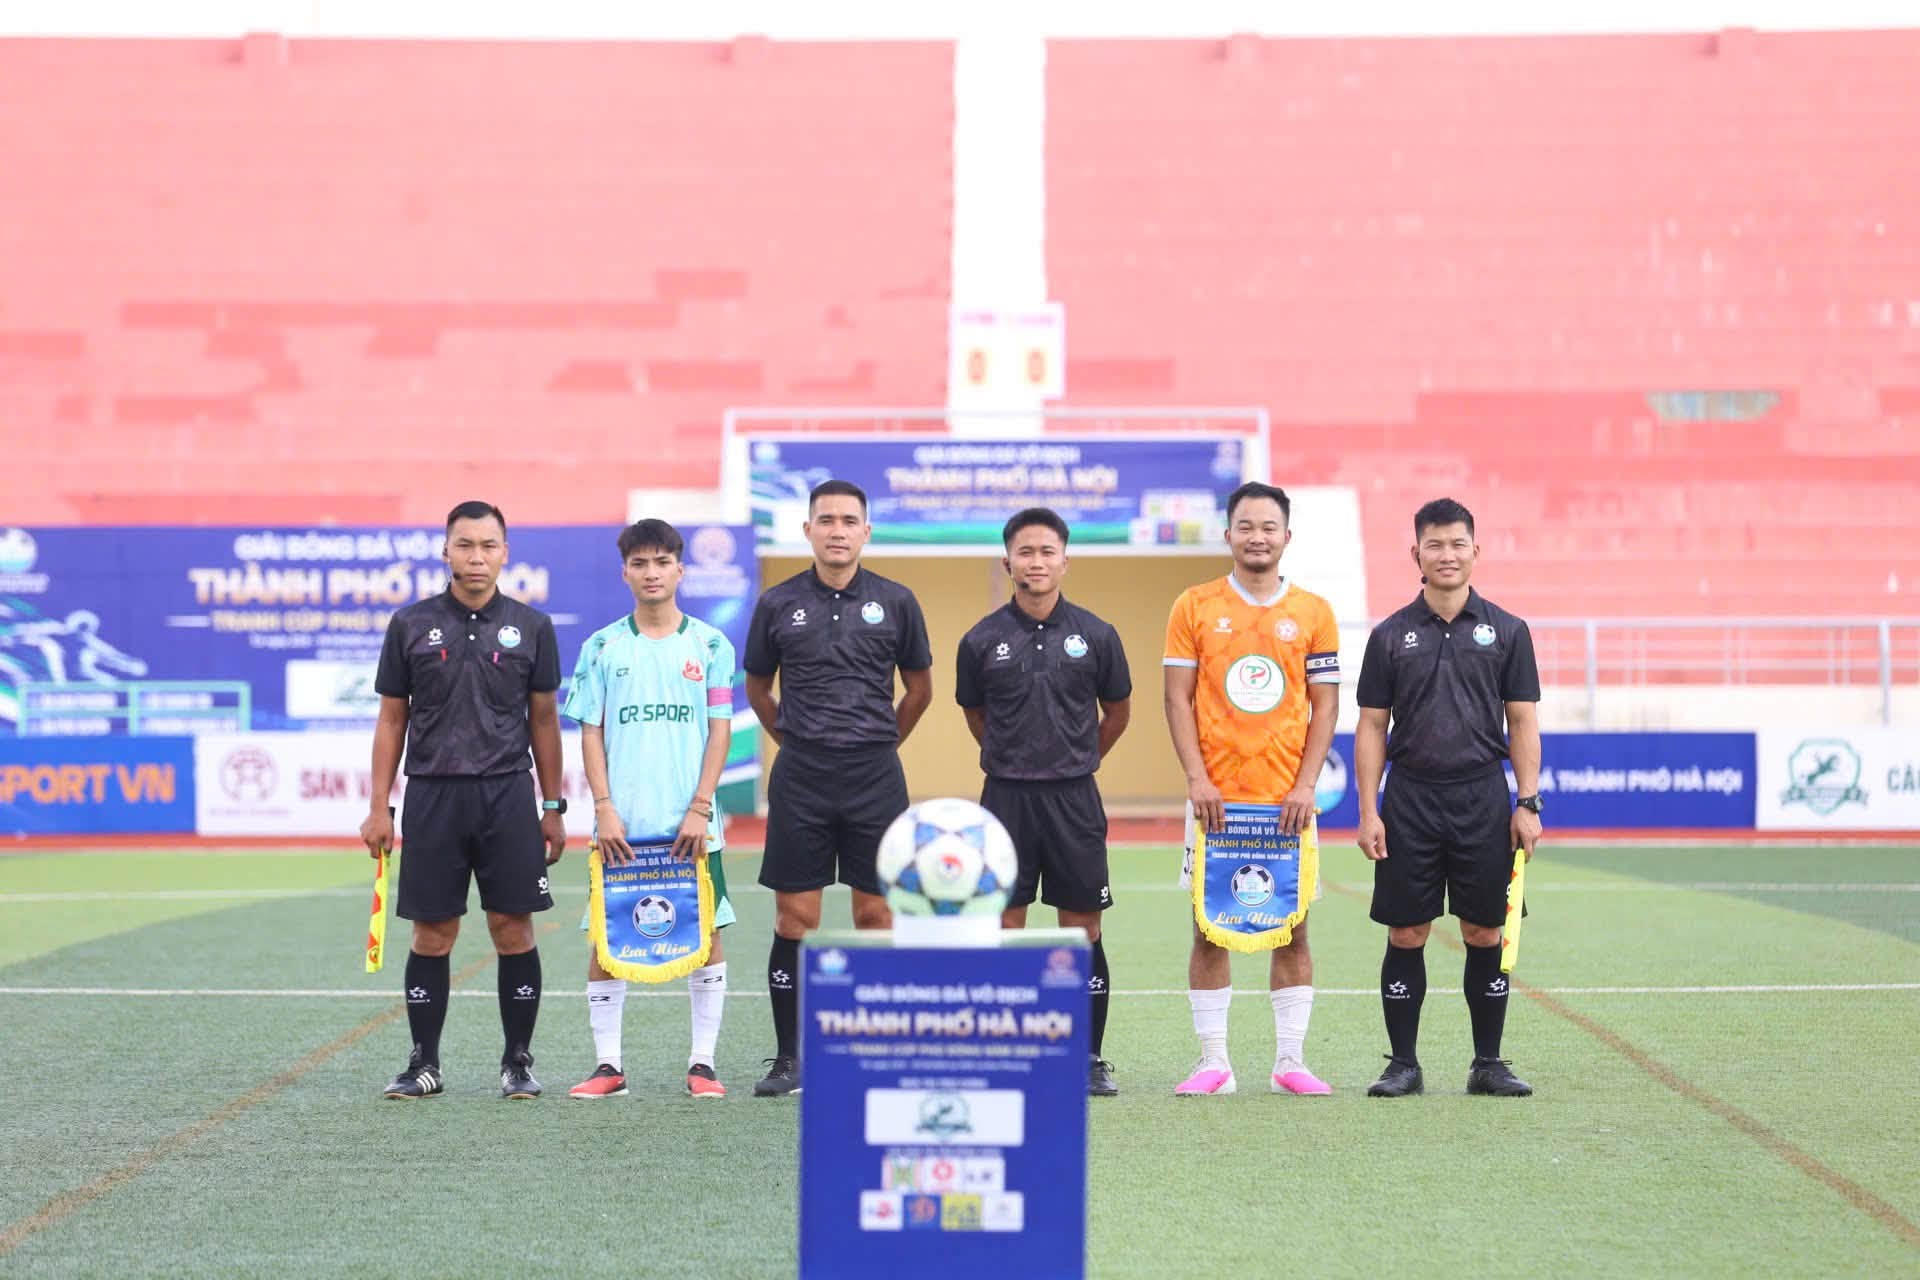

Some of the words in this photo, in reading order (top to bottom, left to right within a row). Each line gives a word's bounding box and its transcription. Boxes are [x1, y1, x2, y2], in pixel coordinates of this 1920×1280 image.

[885, 465, 972, 492] THÀNH
[975, 464, 1029, 492] PHỐ
[1030, 465, 1068, 492] HÀ
[188, 560, 323, 606] THÀNH
[328, 559, 413, 606] PHỐ
[116, 764, 176, 804] VN
[1673, 764, 1704, 792] HÀ
[1207, 837, 1239, 848] THÀNH
[1241, 837, 1262, 849] PHỐ
[1264, 839, 1277, 849] HÀ
[1280, 839, 1297, 851] NỘI
[607, 871, 637, 883] THÀNH
[640, 868, 660, 881] PHỐ
[662, 869, 676, 880] HÀ
[651, 942, 691, 958] Niệm
[817, 1006, 910, 1036] THÀNH
[914, 1007, 975, 1036] PHỐ
[977, 1007, 1019, 1036] HÀ
[1022, 1009, 1073, 1040] NỘI
